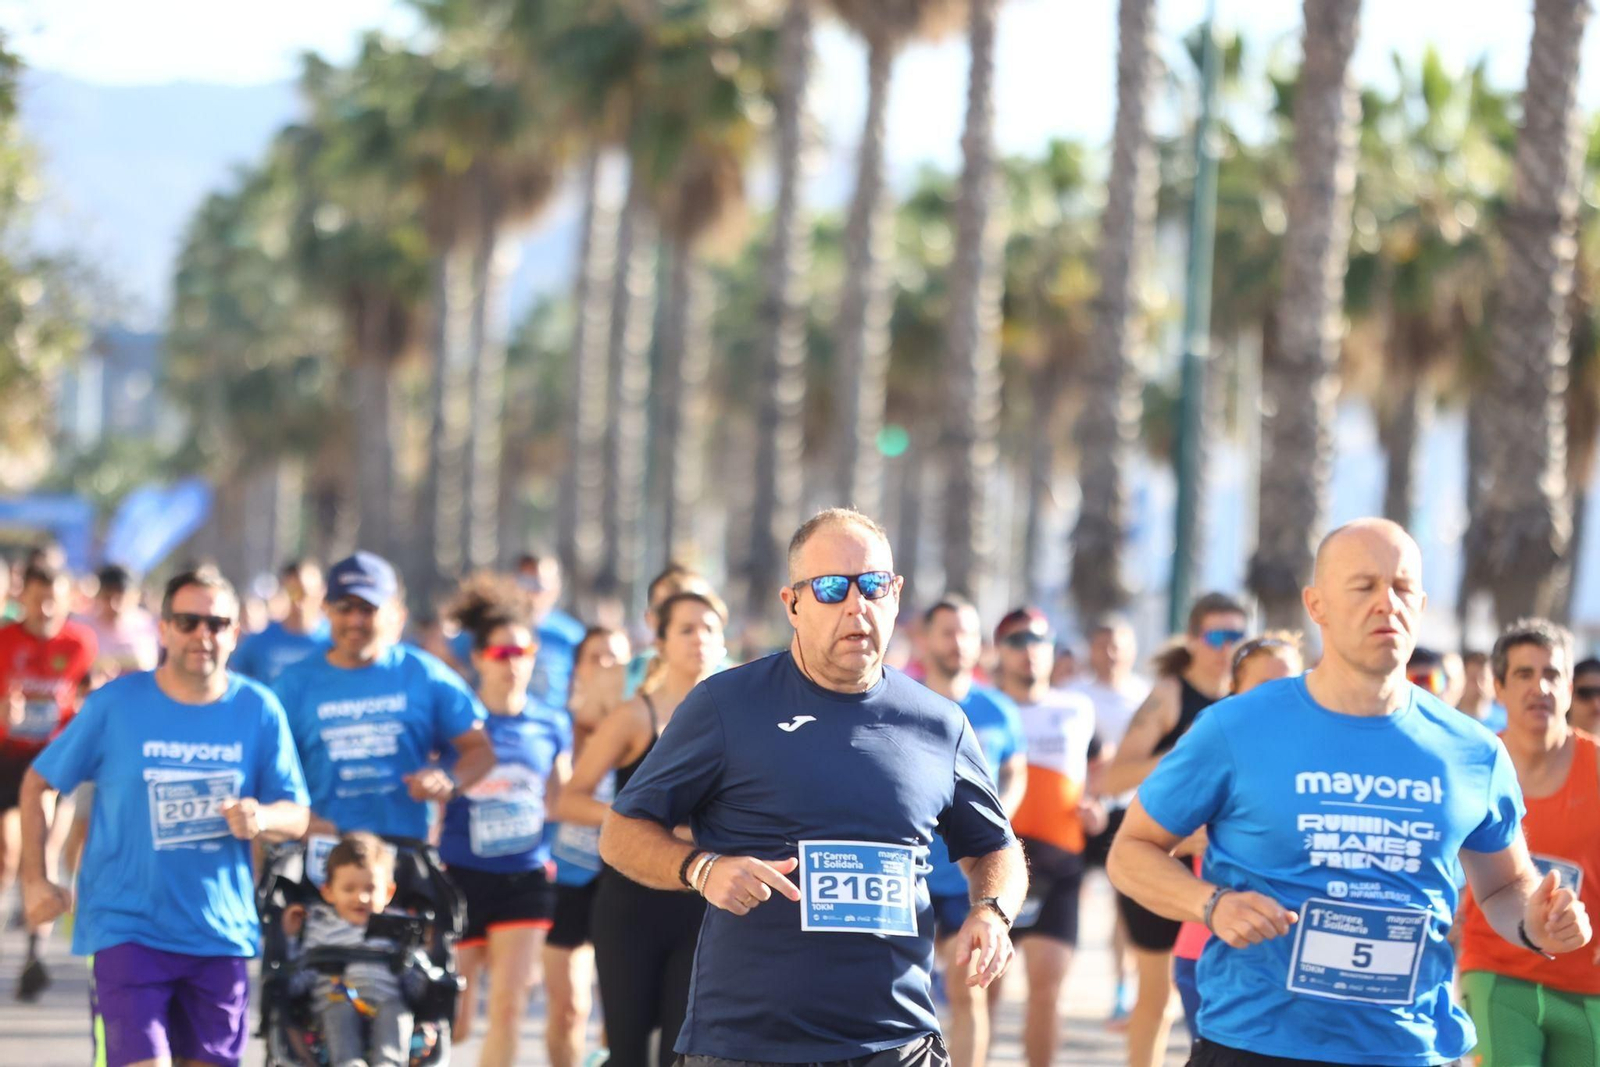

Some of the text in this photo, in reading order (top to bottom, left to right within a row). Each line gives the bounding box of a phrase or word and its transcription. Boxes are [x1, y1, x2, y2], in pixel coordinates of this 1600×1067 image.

[143, 740, 243, 763] mayoral
[1296, 771, 1442, 804] mayoral
[1297, 814, 1435, 841] RUNNING
[1312, 833, 1422, 857] MAKES
[823, 852, 858, 862] Carrera
[823, 860, 864, 870] Solidaria
[1309, 851, 1422, 873] FRIENDS
[818, 875, 902, 904] 2162
[811, 903, 834, 911] 10KM
[1322, 919, 1369, 935] Solidaria
[1324, 910, 1364, 925] Carrera
[1385, 915, 1423, 925] mayoral
[1351, 942, 1374, 968] 5
[1300, 963, 1326, 975] 10KM
